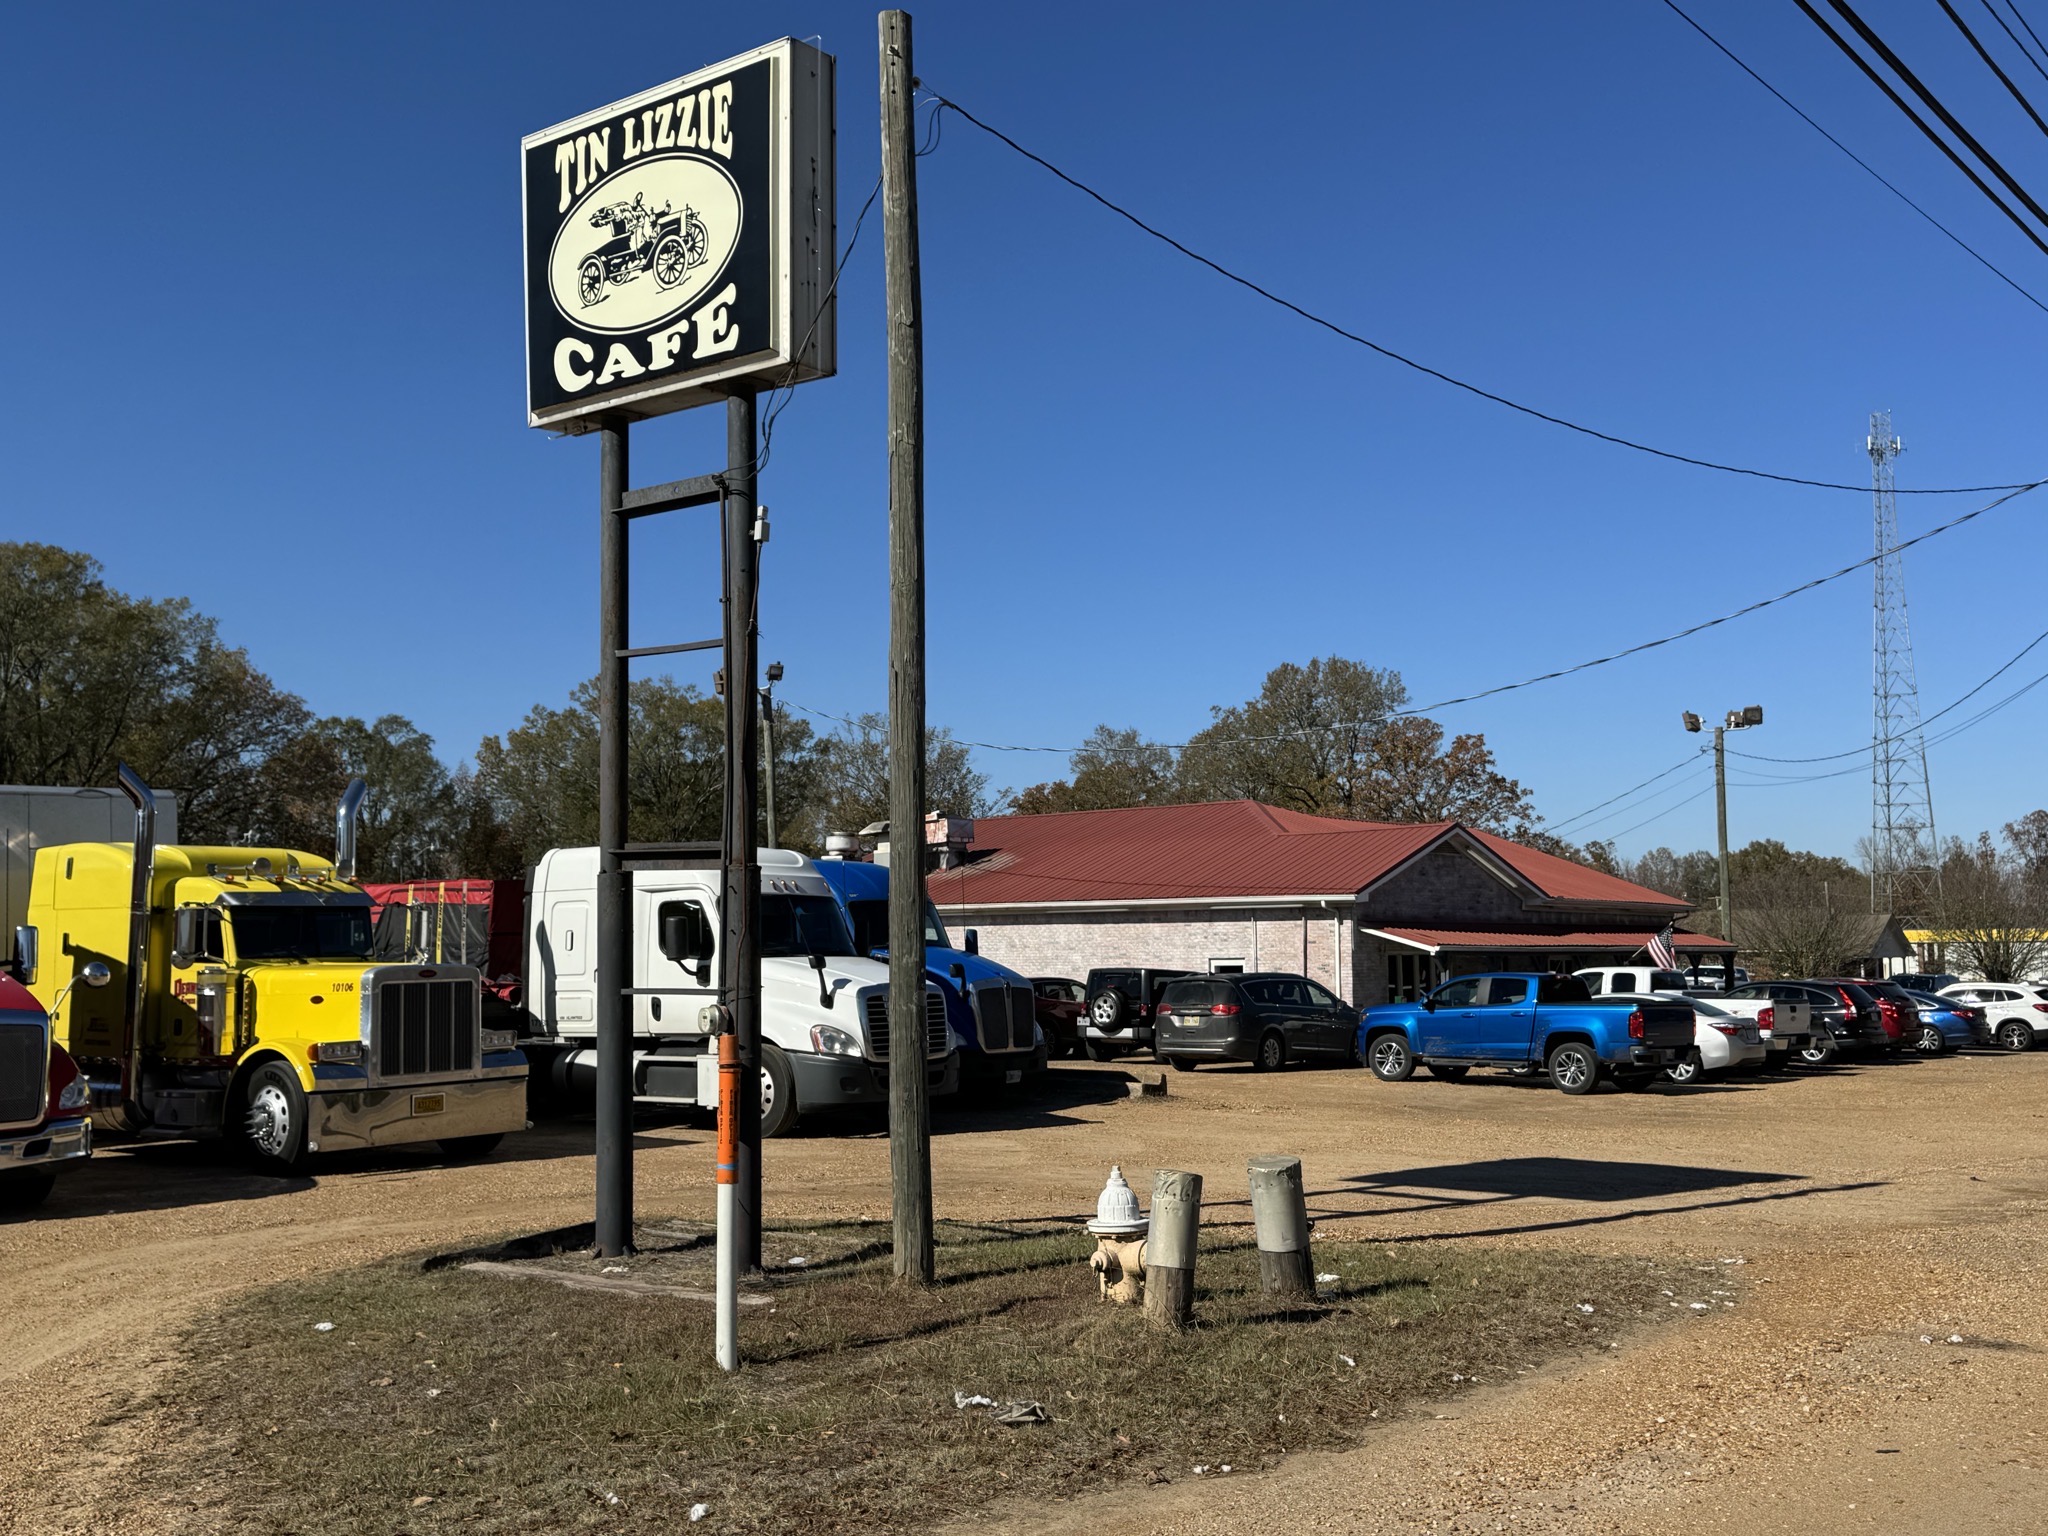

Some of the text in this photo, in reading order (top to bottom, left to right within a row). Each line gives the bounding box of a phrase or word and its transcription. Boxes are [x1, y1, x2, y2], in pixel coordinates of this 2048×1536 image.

[555, 80, 733, 213] TIN LIZZIE
[554, 282, 739, 393] CAFE
[332, 982, 354, 992] 10106
